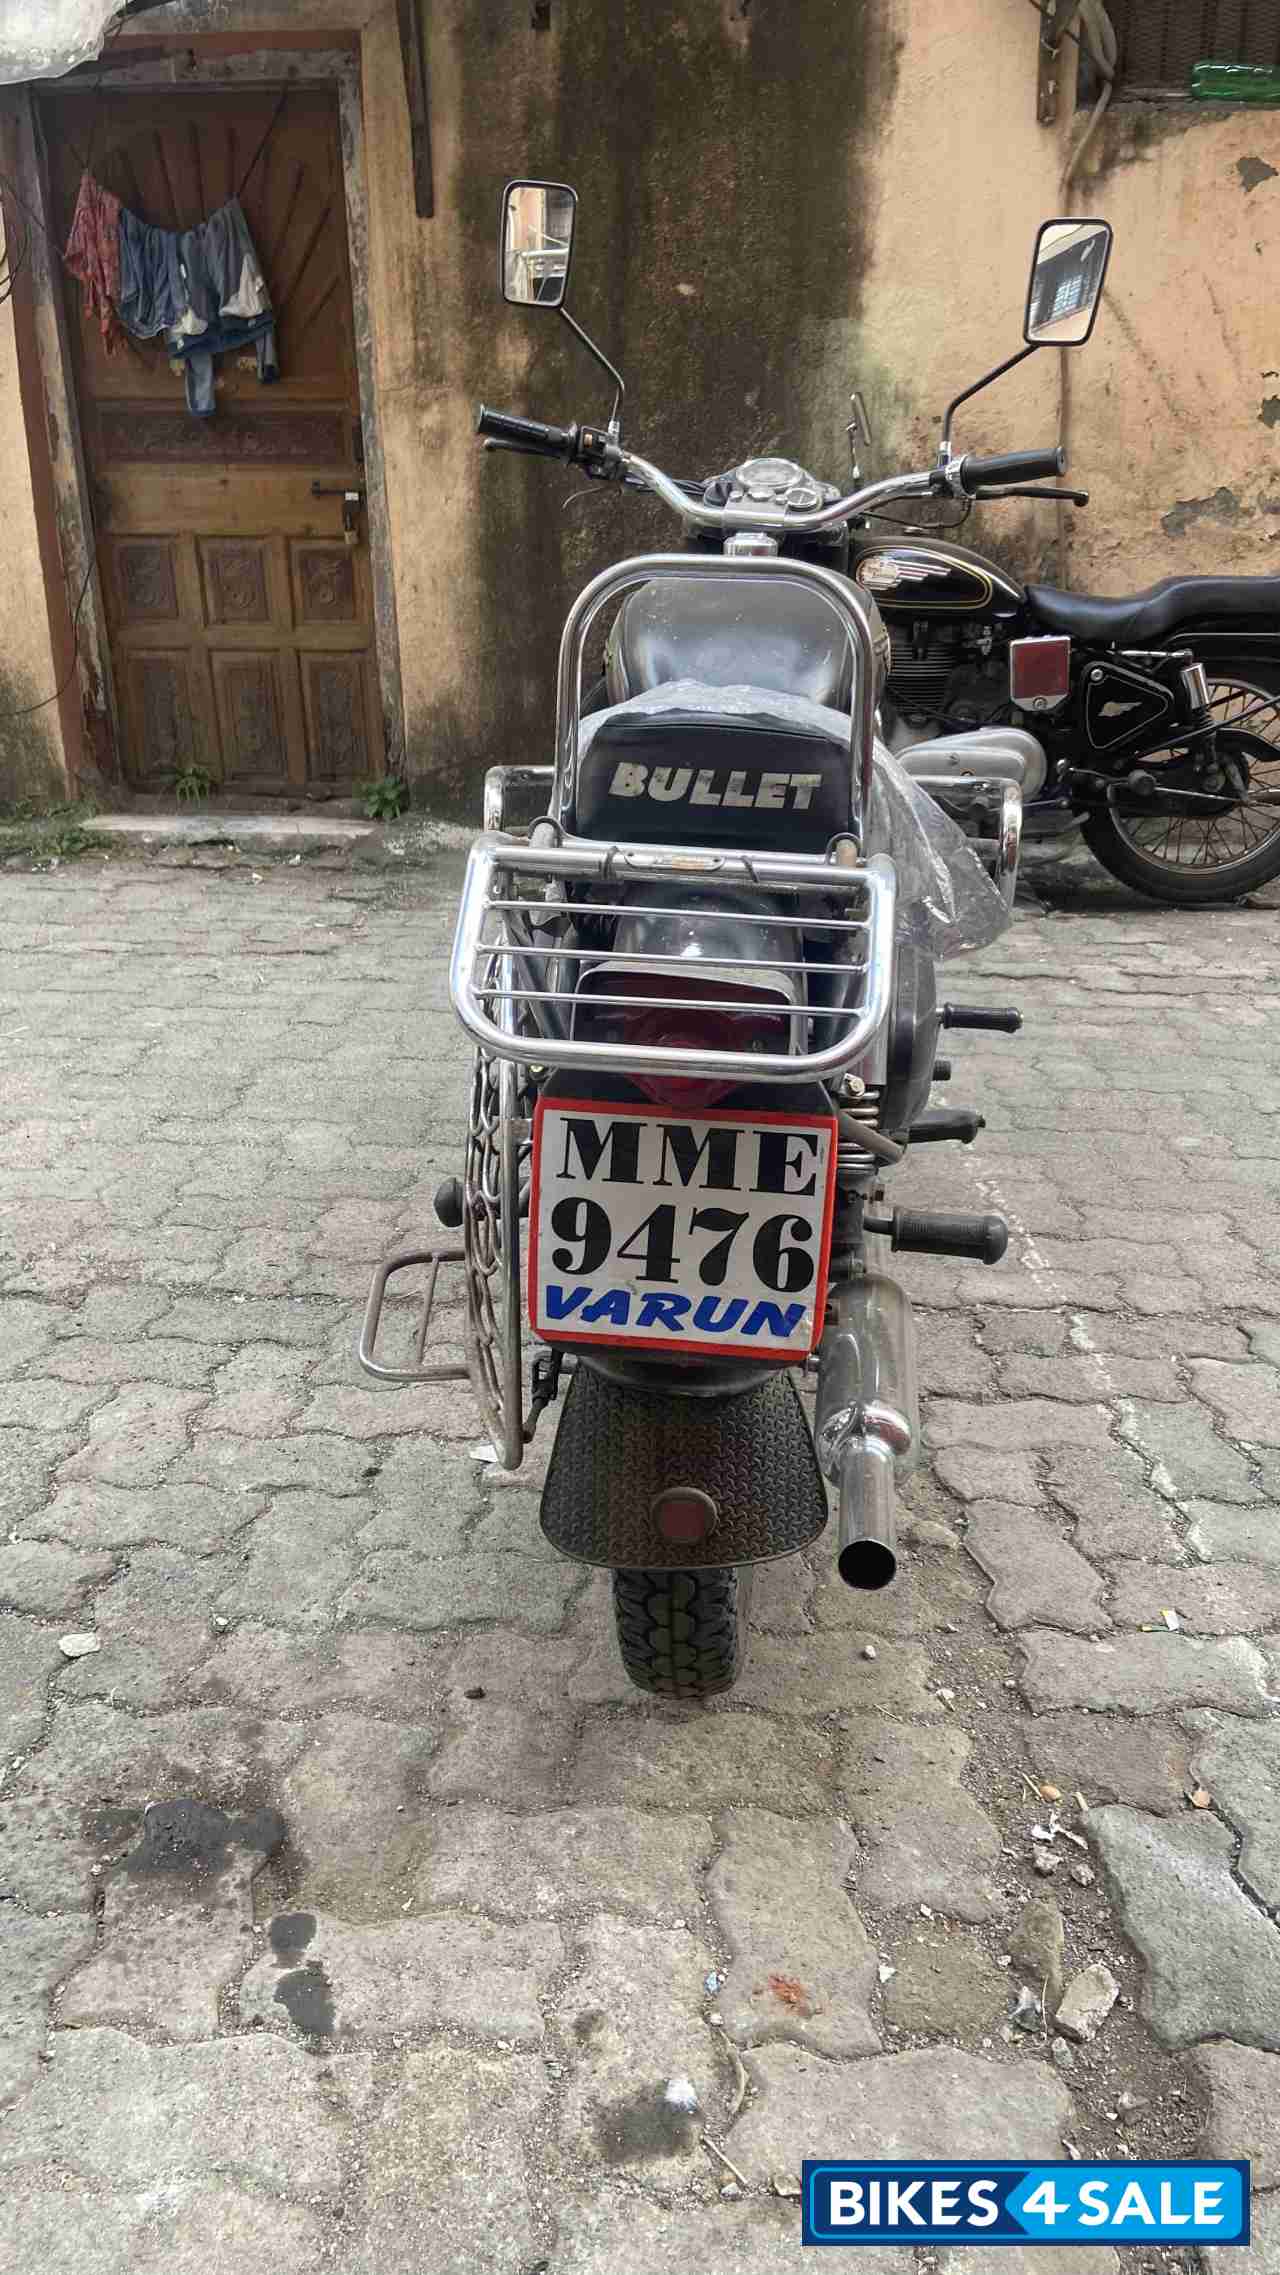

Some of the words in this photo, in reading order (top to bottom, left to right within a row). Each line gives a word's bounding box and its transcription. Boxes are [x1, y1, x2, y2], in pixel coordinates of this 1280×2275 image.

[608, 762, 822, 809] BULLET
[556, 1117, 819, 1196] MME
[551, 1197, 815, 1292] 9476
[545, 1285, 806, 1338] VARUN
